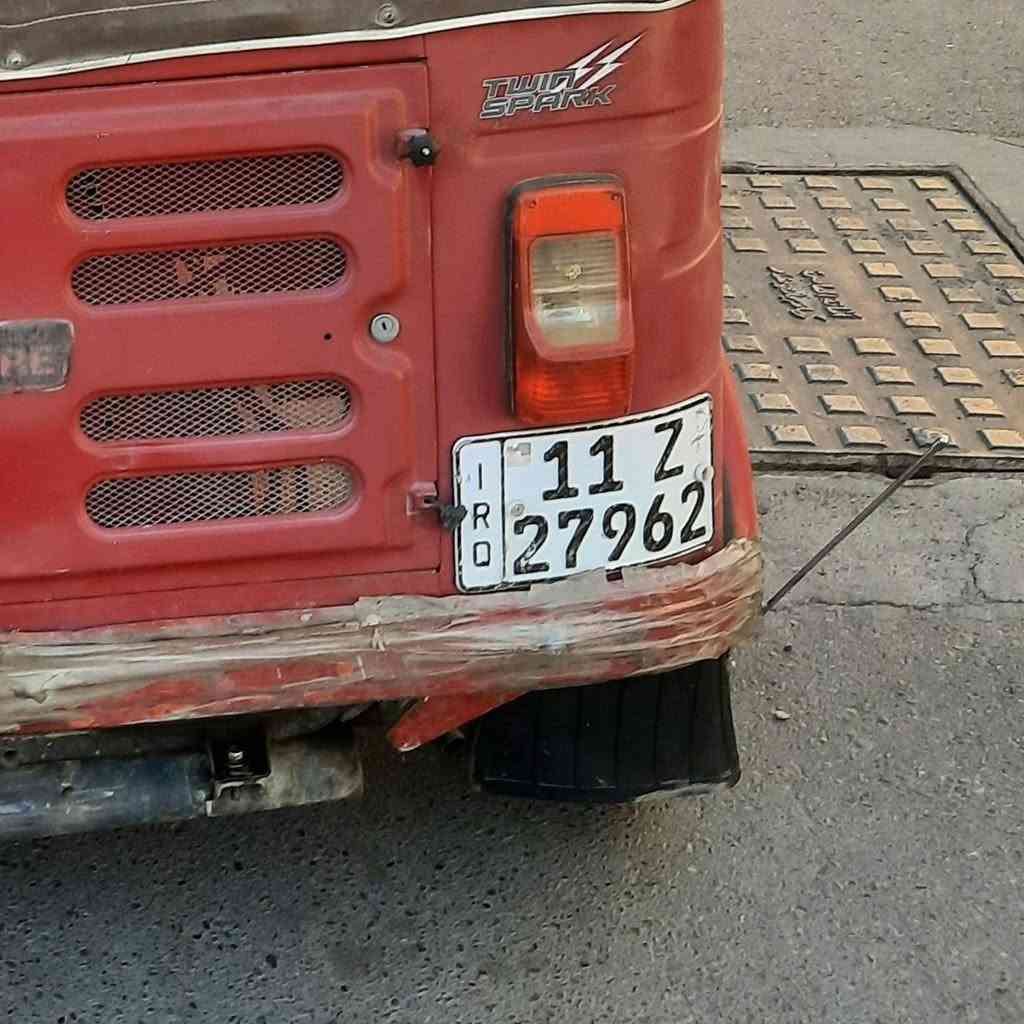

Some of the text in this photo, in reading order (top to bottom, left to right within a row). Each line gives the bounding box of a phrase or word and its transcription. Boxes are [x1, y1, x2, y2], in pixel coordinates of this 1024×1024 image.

[480, 84, 616, 119] SPARK
[482, 69, 578, 99] TWIN
[542, 417, 684, 501] 11 Z
[513, 480, 707, 576] 27962
